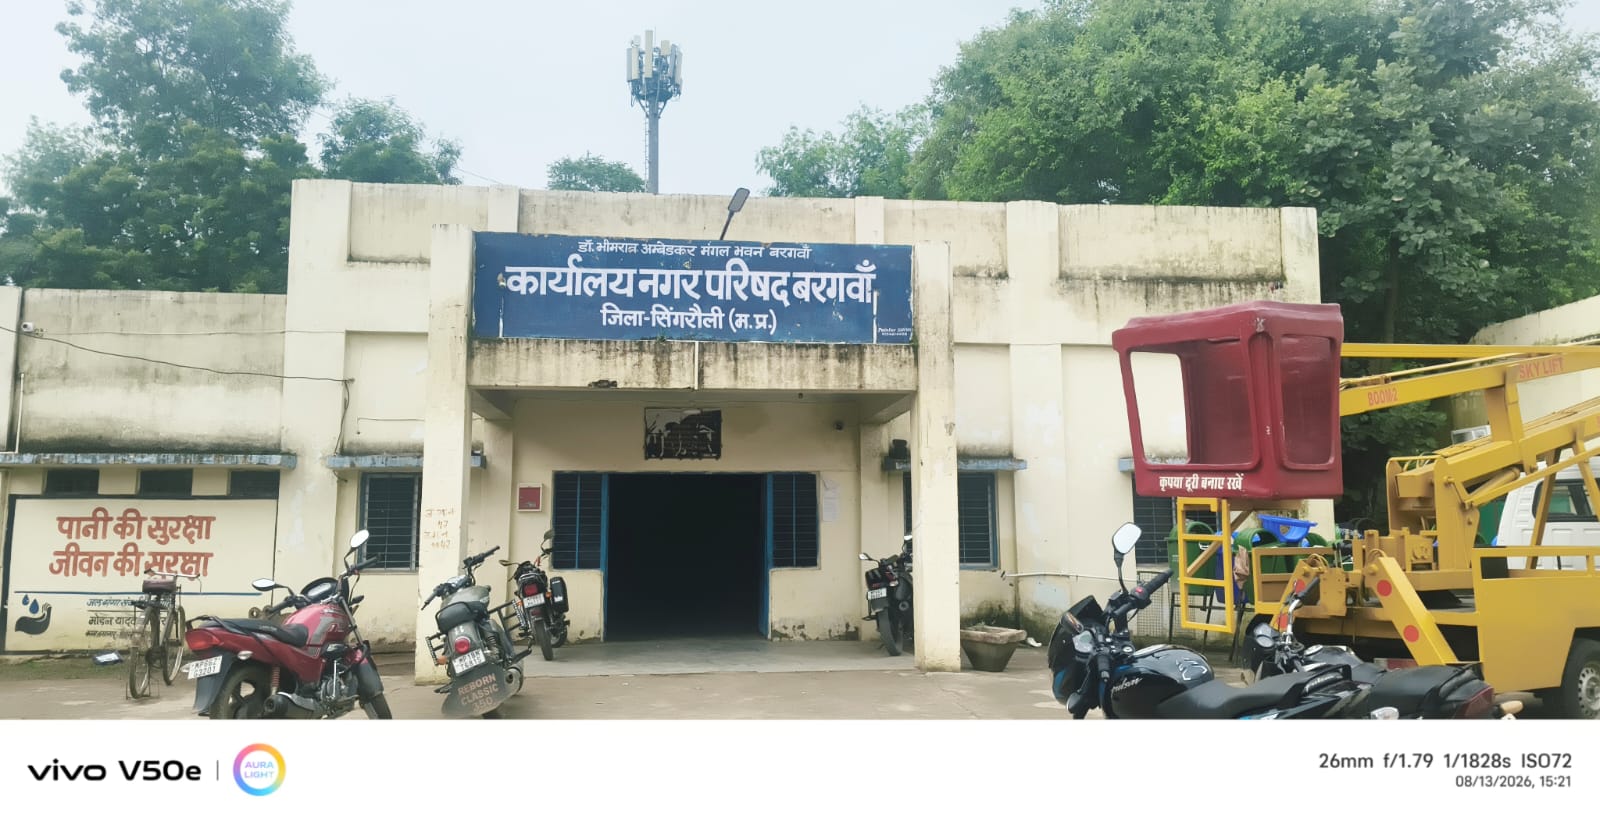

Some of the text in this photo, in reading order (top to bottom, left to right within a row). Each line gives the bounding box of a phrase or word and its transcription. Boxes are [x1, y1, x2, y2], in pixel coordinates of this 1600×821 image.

[640, 240, 698, 257] अम्बेडकर
[700, 243, 732, 257] मंगल
[733, 246, 764, 258] भवन
[769, 243, 813, 259] बरगवाँ
[504, 253, 877, 307] कार्यालय नगर परिषद बरगवाँ
[728, 308, 778, 336] (म.प्र.)
[1519, 356, 1563, 380] SKY LIFT
[1158, 473, 1245, 492] कृपया दूरी बनाए रखें
[56, 506, 217, 545] पानी की सुरक्षा
[49, 541, 115, 577] जीवन
[113, 541, 145, 577] की
[457, 673, 497, 696] REBORN
[460, 683, 499, 706] CLASSIC
[472, 696, 494, 713] 350
